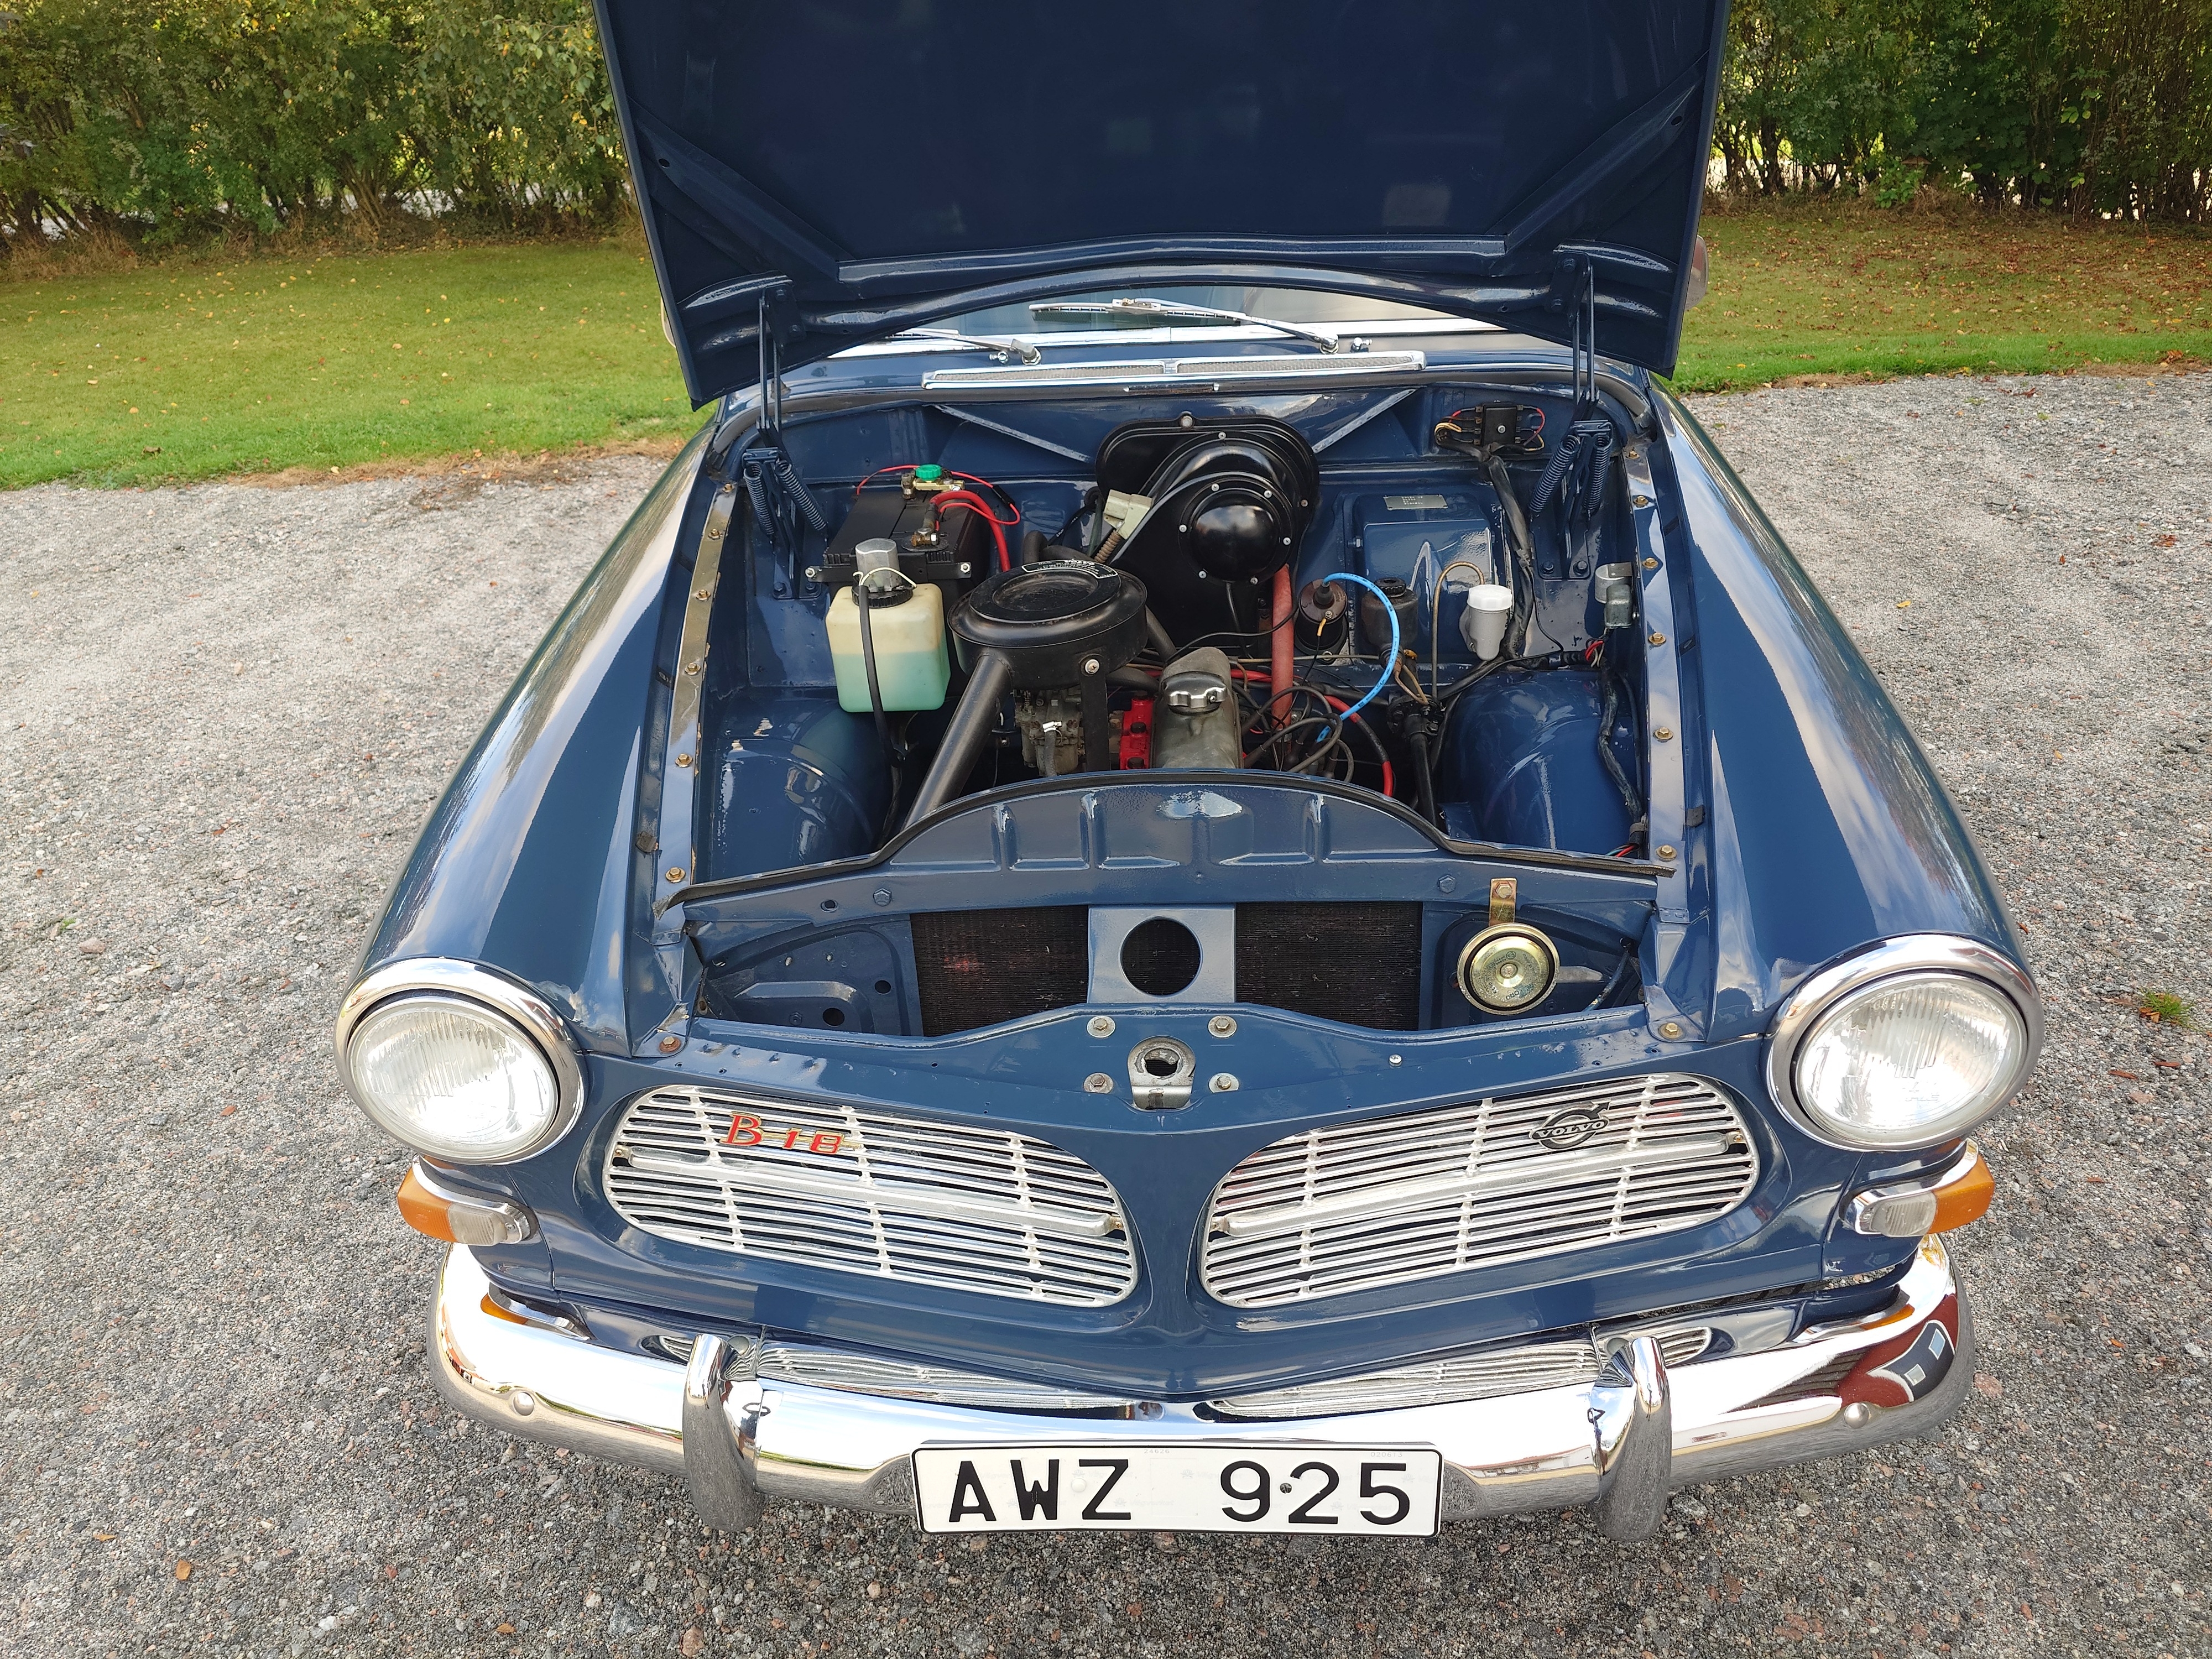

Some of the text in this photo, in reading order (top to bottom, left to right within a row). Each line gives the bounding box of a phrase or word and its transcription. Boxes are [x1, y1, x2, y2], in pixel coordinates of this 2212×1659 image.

[1536, 1121, 1605, 1138] VOLVO
[948, 1459, 1410, 1526] AWZ 925
